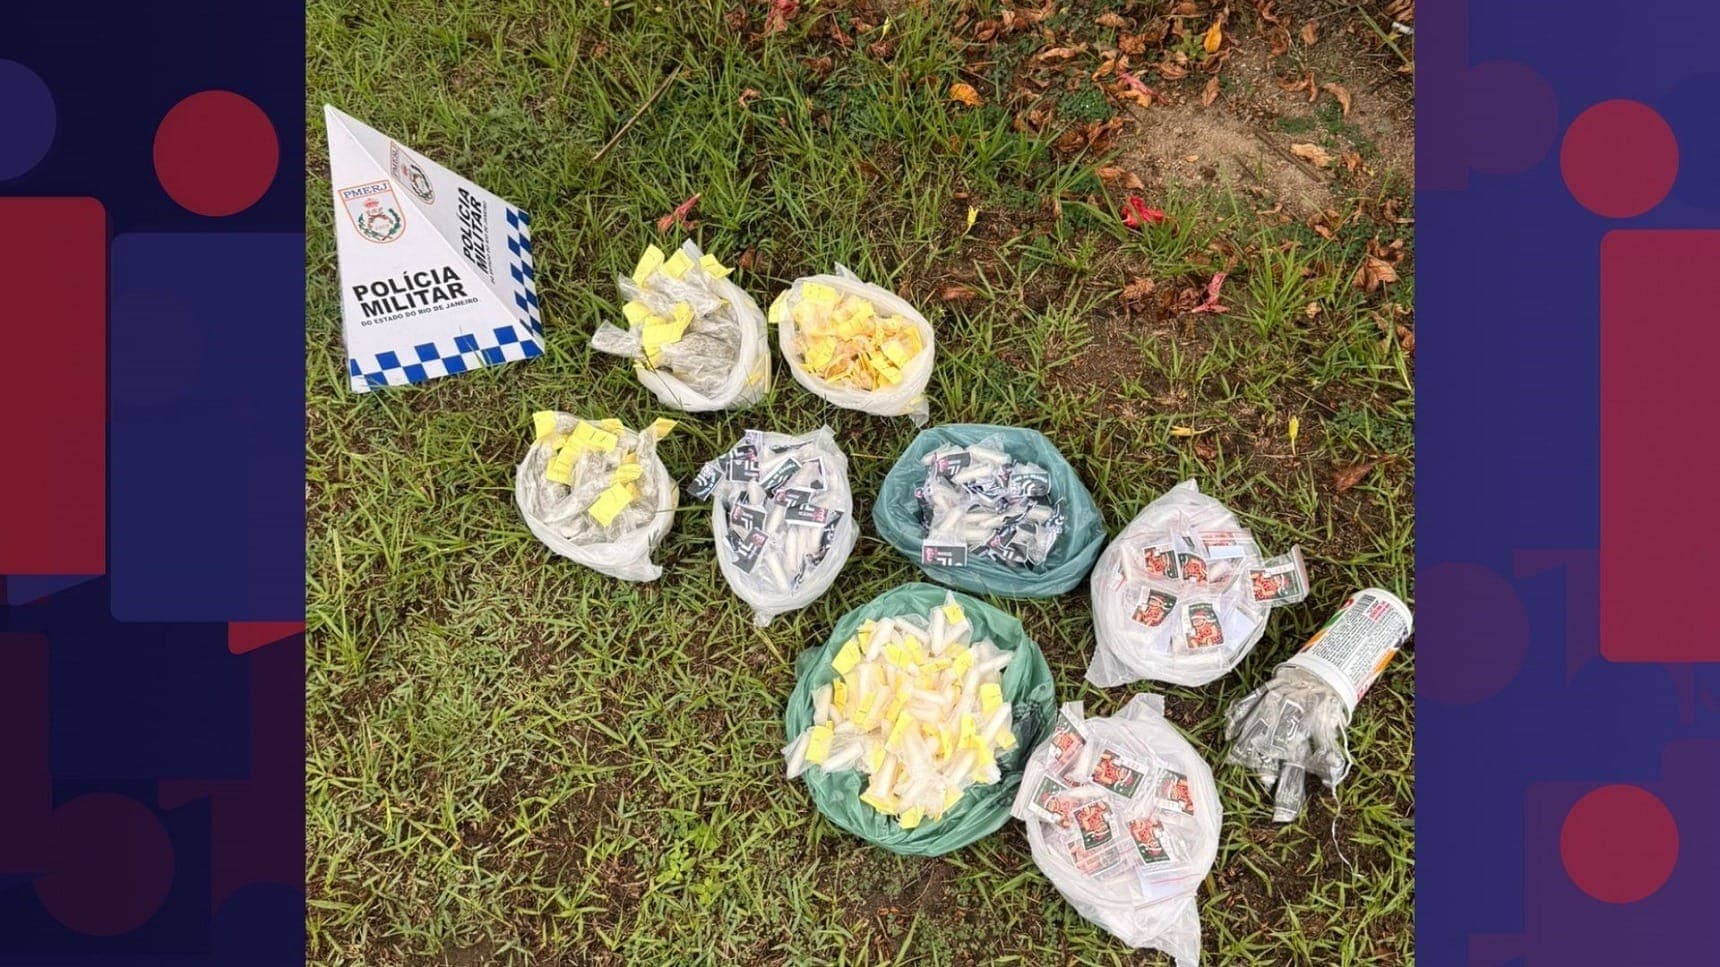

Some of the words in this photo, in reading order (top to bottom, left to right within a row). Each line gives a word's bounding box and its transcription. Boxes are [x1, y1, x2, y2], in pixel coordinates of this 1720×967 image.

[343, 183, 388, 199] PMERJ
[456, 187, 476, 264] POLÍCIA
[470, 195, 489, 275] MILITAR
[352, 265, 461, 302] POLÍCIA
[360, 282, 468, 318] MILITAR
[374, 313, 404, 325] ESTADO
[418, 307, 432, 315] RIO
[445, 297, 479, 309] JANEIRO
